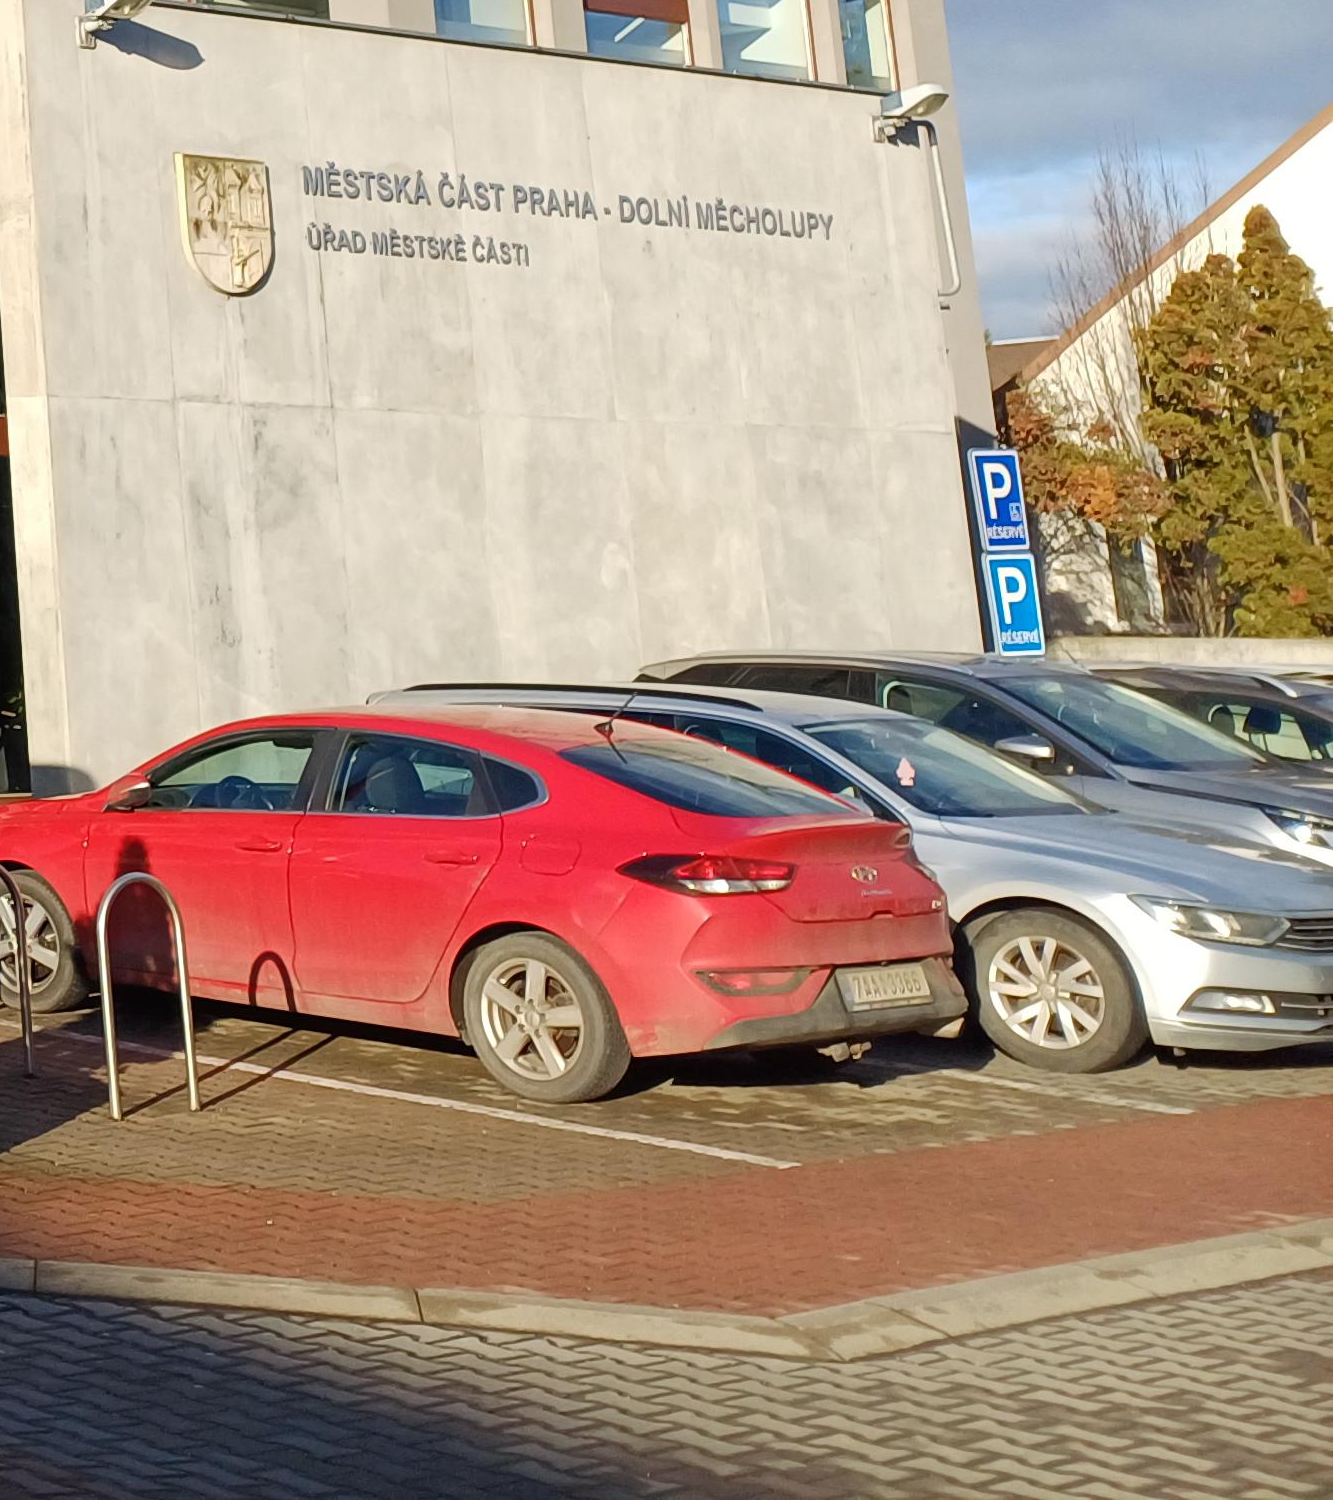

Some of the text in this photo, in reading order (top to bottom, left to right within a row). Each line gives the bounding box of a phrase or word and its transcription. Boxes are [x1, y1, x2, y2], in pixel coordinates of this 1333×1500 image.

[302, 161, 431, 206] MĚSTSKÁ
[438, 172, 505, 212] ČÁST
[512, 184, 598, 221] PRAHA
[618, 195, 690, 228] DOLNÍ
[696, 197, 833, 241] MĚCHOLUPY
[306, 222, 531, 267] ÚŘAD MĚSTSKÉ ČÁSTI
[982, 462, 1012, 520] P
[996, 566, 1027, 625] P
